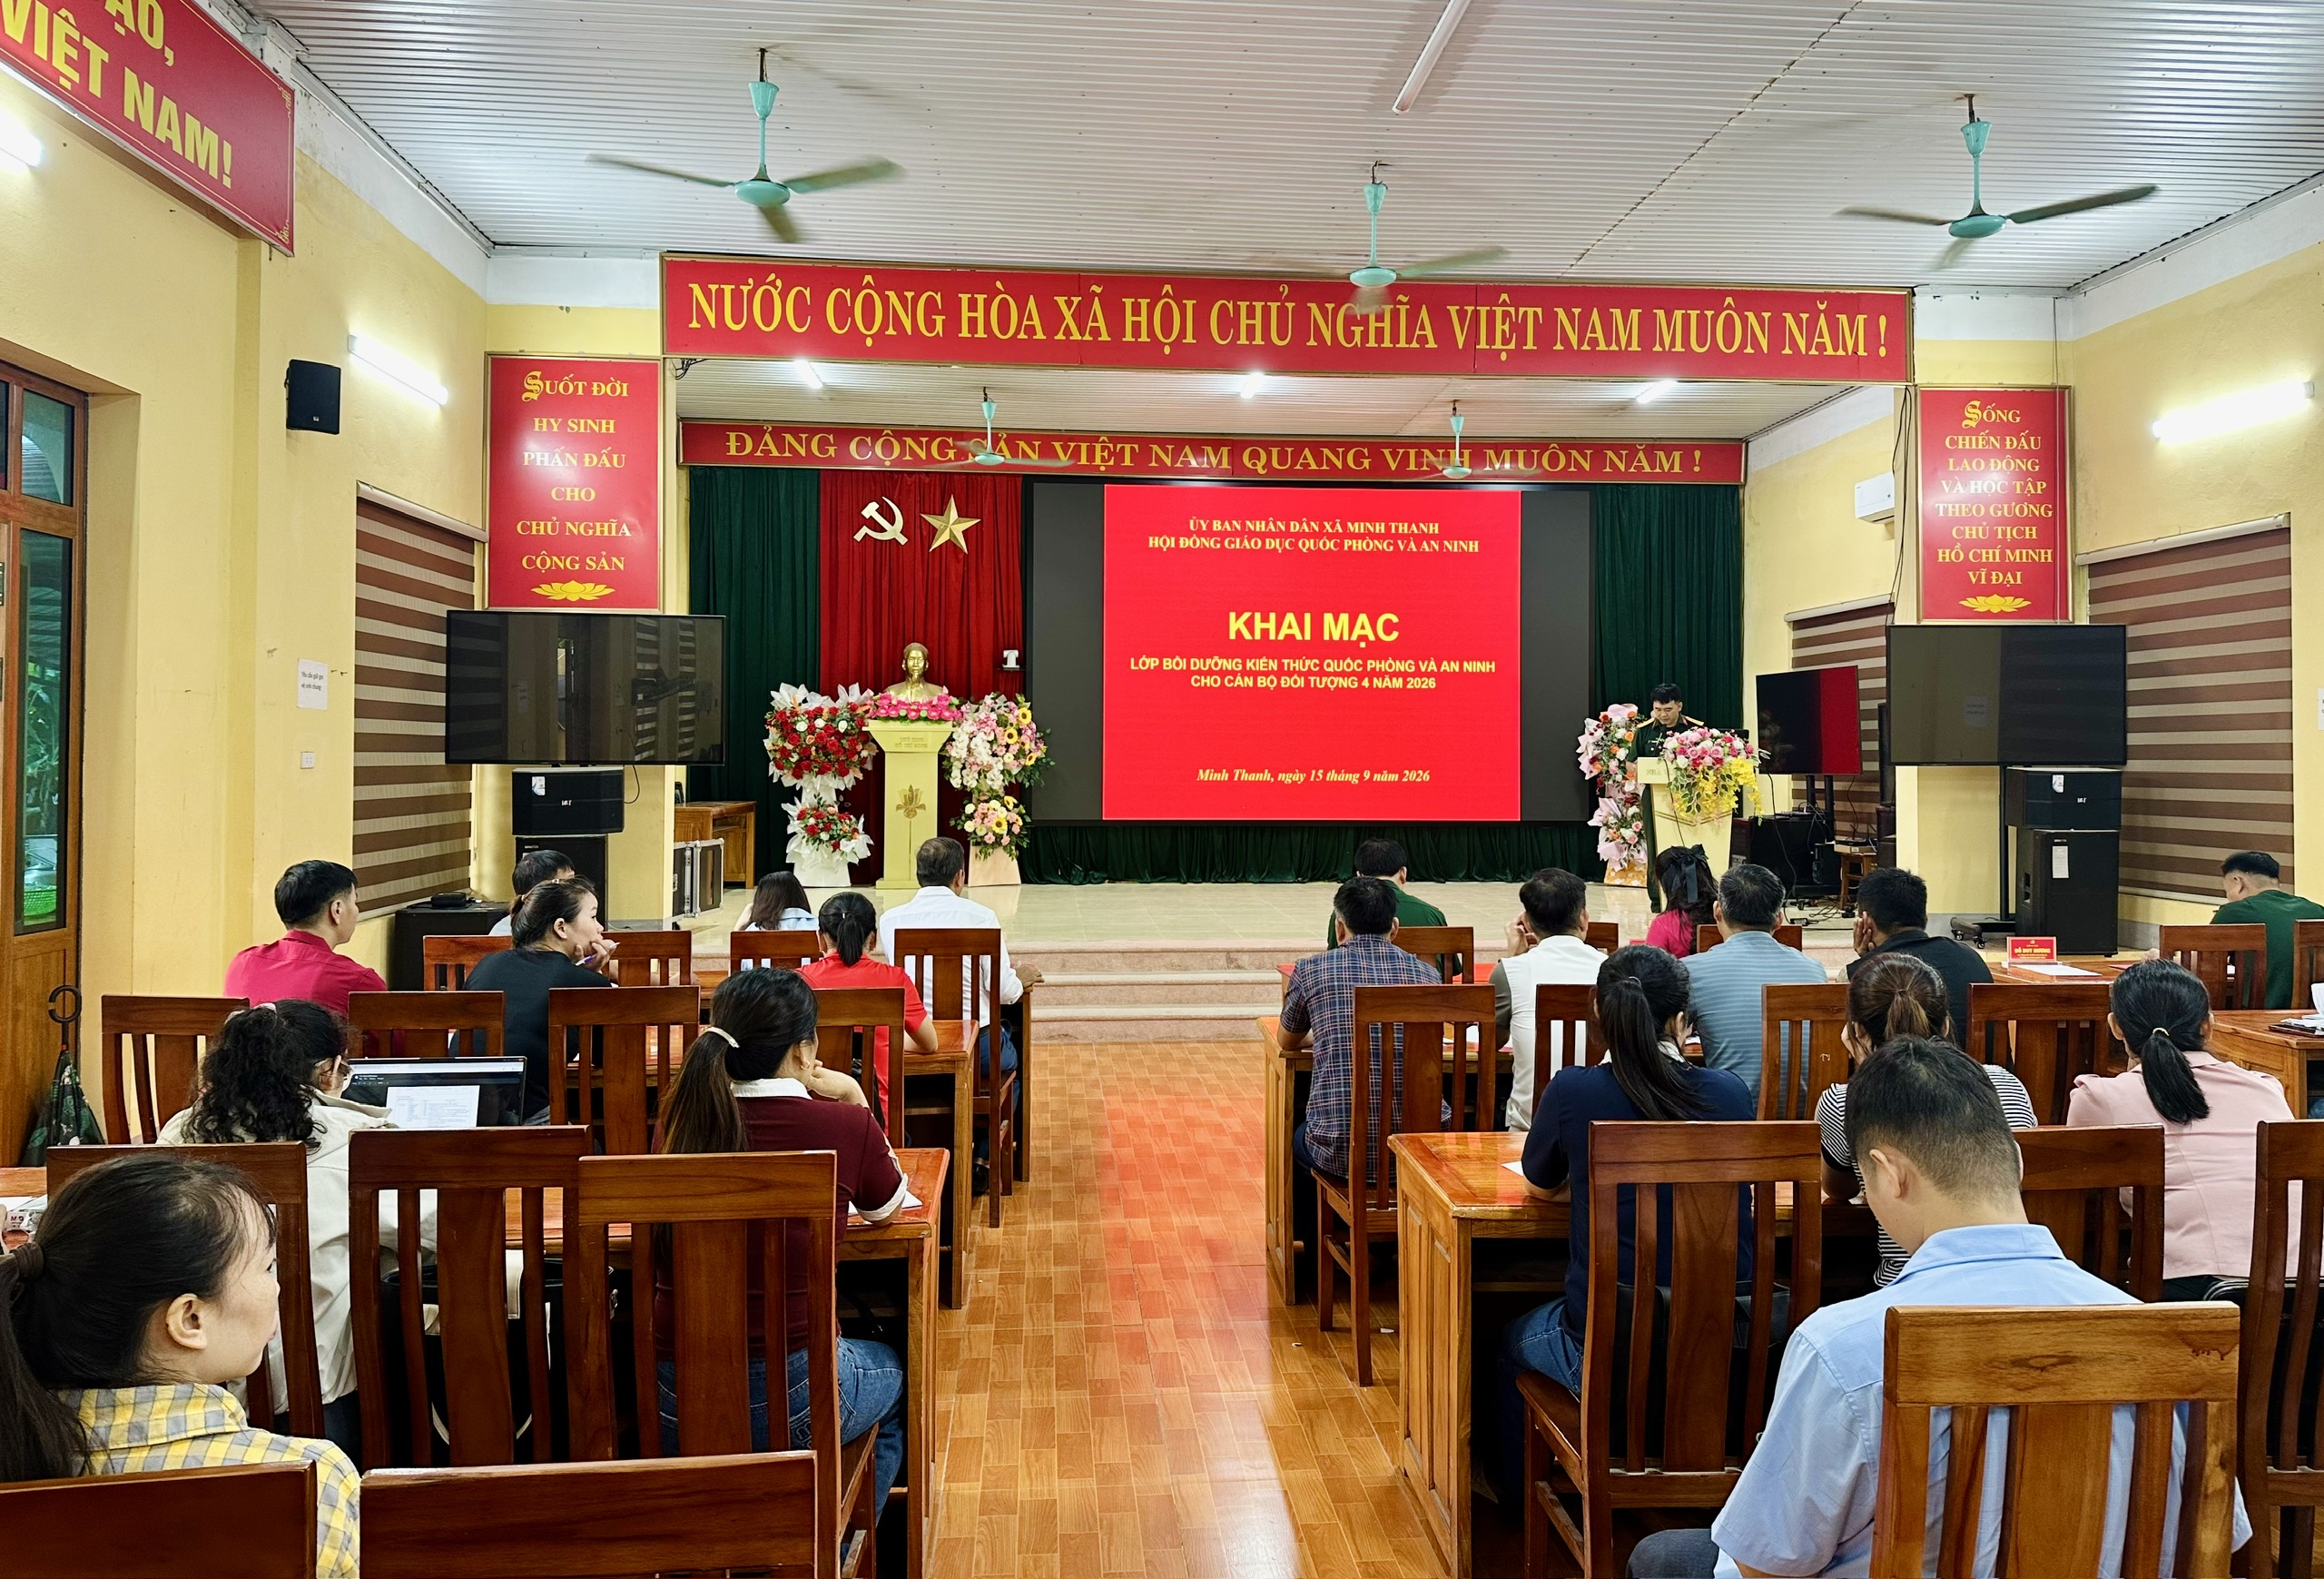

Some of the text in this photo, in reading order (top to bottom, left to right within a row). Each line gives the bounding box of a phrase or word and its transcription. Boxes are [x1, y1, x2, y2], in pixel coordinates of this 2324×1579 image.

[0, 0, 231, 189] VIỆT NAM!
[689, 273, 1886, 360] NƯỚC CỘNG HÒA XÃ HỘI CHỦ NGHĨA VIỆT NAM MUÔN NĂM !
[522, 371, 628, 401] SUỐT ĐỜI
[1962, 400, 2020, 429] SỐNG
[533, 419, 615, 433] HY SINH
[726, 424, 838, 458] ĐẢNG
[847, 428, 958, 468] CỘNG
[1050, 435, 1140, 473] VIỆT
[1148, 445, 1231, 469] NAM
[1243, 447, 1372, 474] QUANG
[1381, 449, 1472, 472] VINH
[1483, 443, 1591, 472] MUÔN
[1601, 442, 1685, 472] NĂM
[1694, 450, 1700, 472] !
[1945, 430, 2041, 449] CHIẾN ĐẤU
[522, 445, 625, 470] PHẤN ĐẤU
[1948, 455, 2041, 473] LAO ĐỘNG
[551, 485, 596, 501] CHO
[1941, 477, 2047, 497] VÀ HỌC TẬP
[1935, 503, 2053, 518] THEO GƯƠNG
[517, 517, 634, 537] CHỦ NGHĨA
[1190, 517, 1438, 534] ỦY BAN NHÂN DÂN XÃ MINH THANH
[1952, 522, 2037, 541] CHỦ TỊCH
[1149, 536, 1175, 551] HỘI
[1225, 535, 1262, 549] GIÁO
[1265, 538, 1295, 553] DỤC
[1344, 537, 1393, 551] PHÒNG
[1396, 536, 1418, 552] VÀ
[1419, 538, 1440, 553] AN
[1443, 541, 1479, 552] NINH
[1938, 543, 2052, 562] HỒ CHÍ MINH
[522, 551, 625, 573] CỘNG SẢN
[1968, 568, 2022, 587] VĨ ĐẠI
[1229, 612, 1399, 647] KHAI MẠC
[1131, 655, 1159, 670] LỚP
[1190, 656, 1242, 670] DƯỠNG
[1282, 656, 1319, 671] THỨC
[1367, 657, 1415, 672] PHÒNG
[1418, 656, 1439, 674] VÀ
[1440, 659, 1461, 674] AN
[1463, 661, 1495, 672] NINH
[1191, 676, 1221, 687] CHO
[1225, 673, 1253, 686] CÁN
[1257, 675, 1277, 690] BỘ
[1308, 676, 1358, 690] TƯỢNG
[1362, 677, 1369, 688] 4
[1374, 675, 1403, 688] NĂM
[1407, 677, 1436, 688] 2026
[1197, 769, 1430, 784] Minh Thanh, ngày 15 tháng 9 năm 2026
